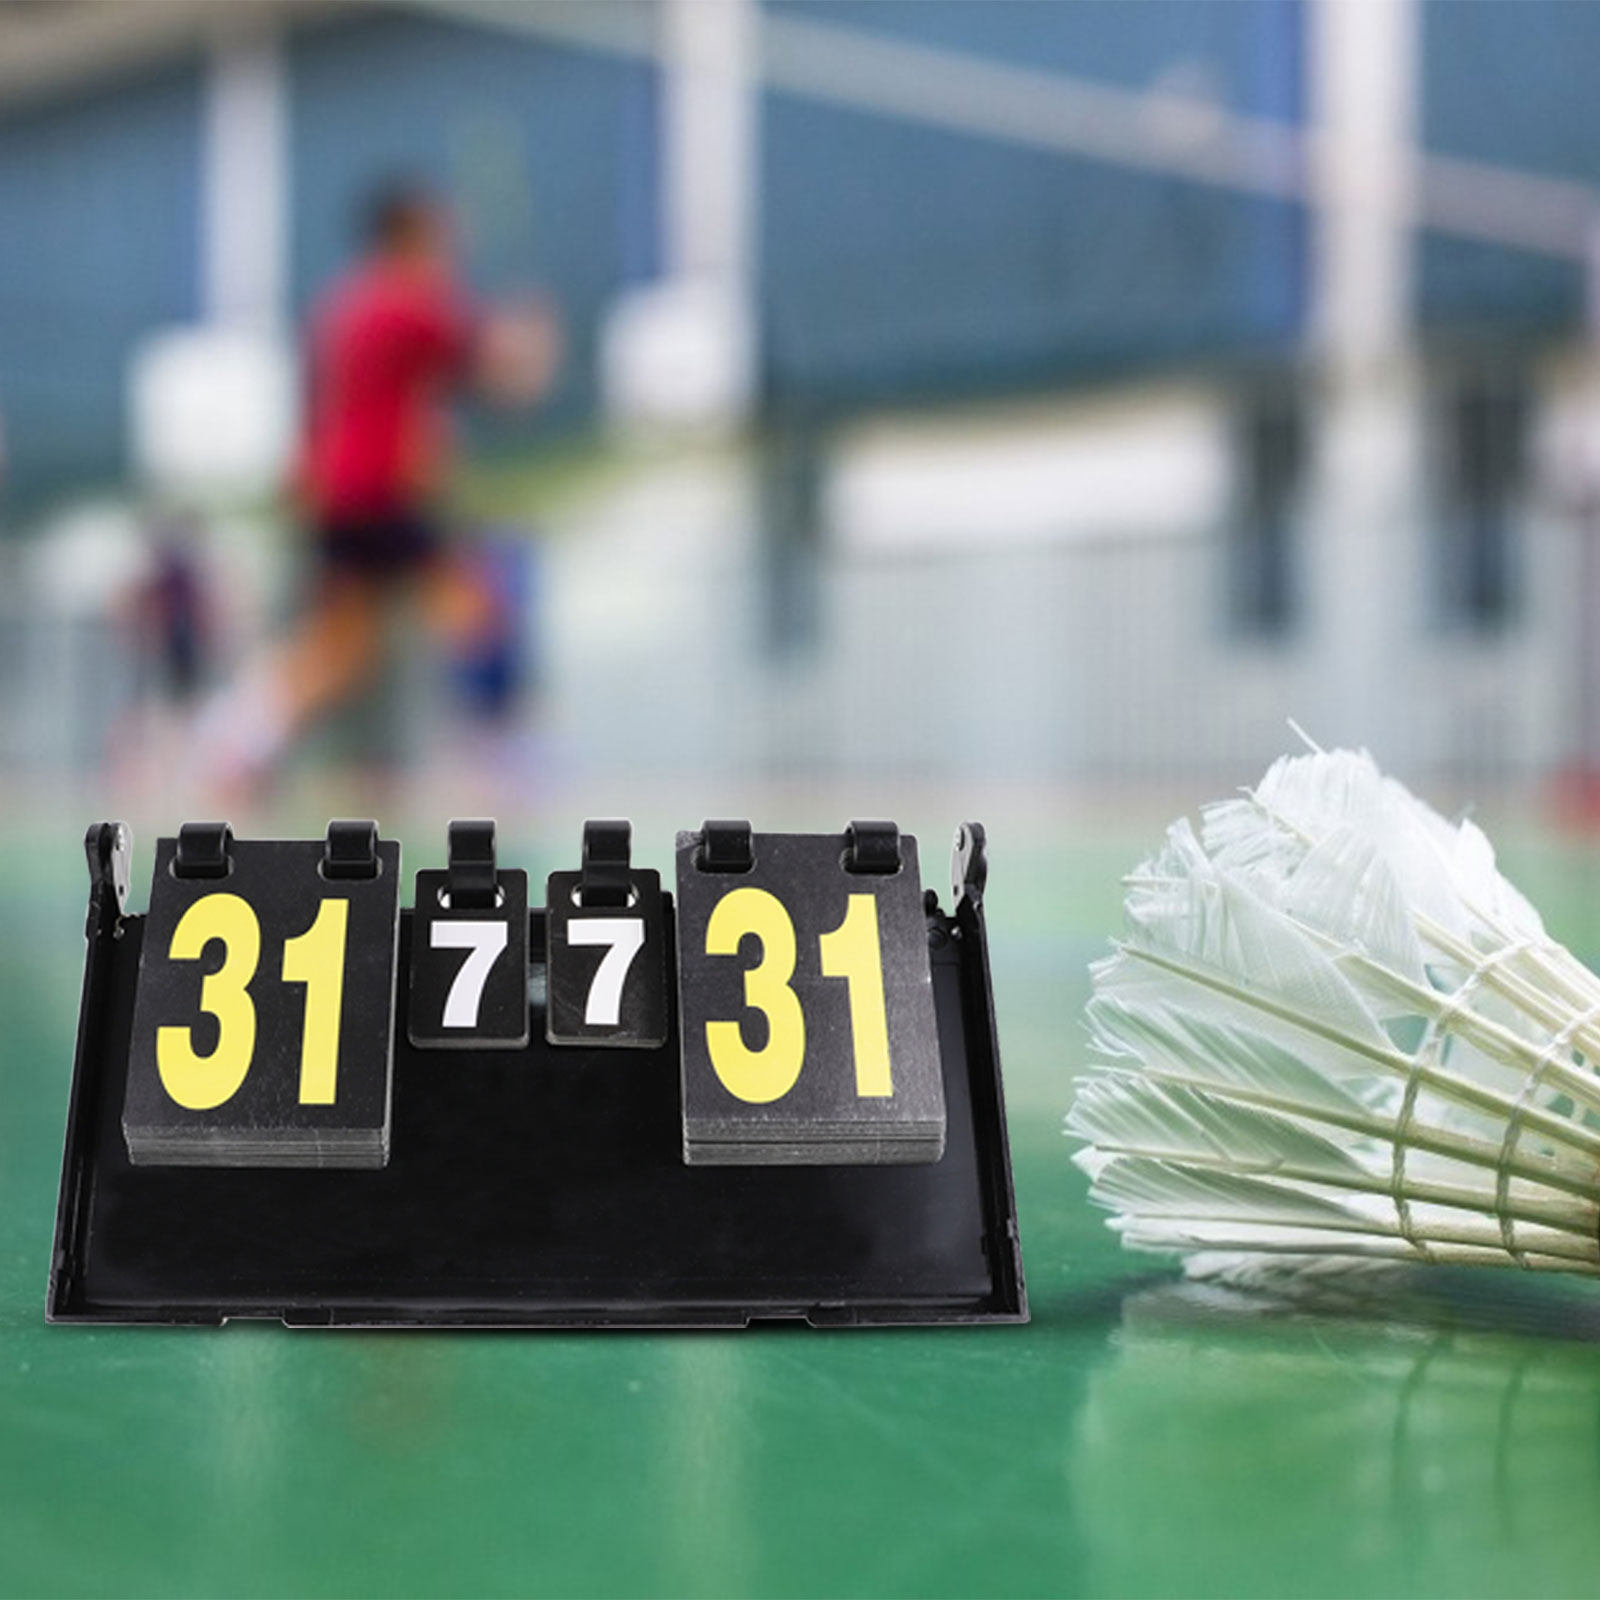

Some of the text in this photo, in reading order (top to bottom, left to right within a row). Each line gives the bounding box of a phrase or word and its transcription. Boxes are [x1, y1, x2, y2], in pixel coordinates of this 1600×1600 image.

[155, 893, 350, 1110] 31
[430, 920, 508, 1028] 7
[567, 918, 645, 1026] 7
[704, 887, 895, 1105] 31
